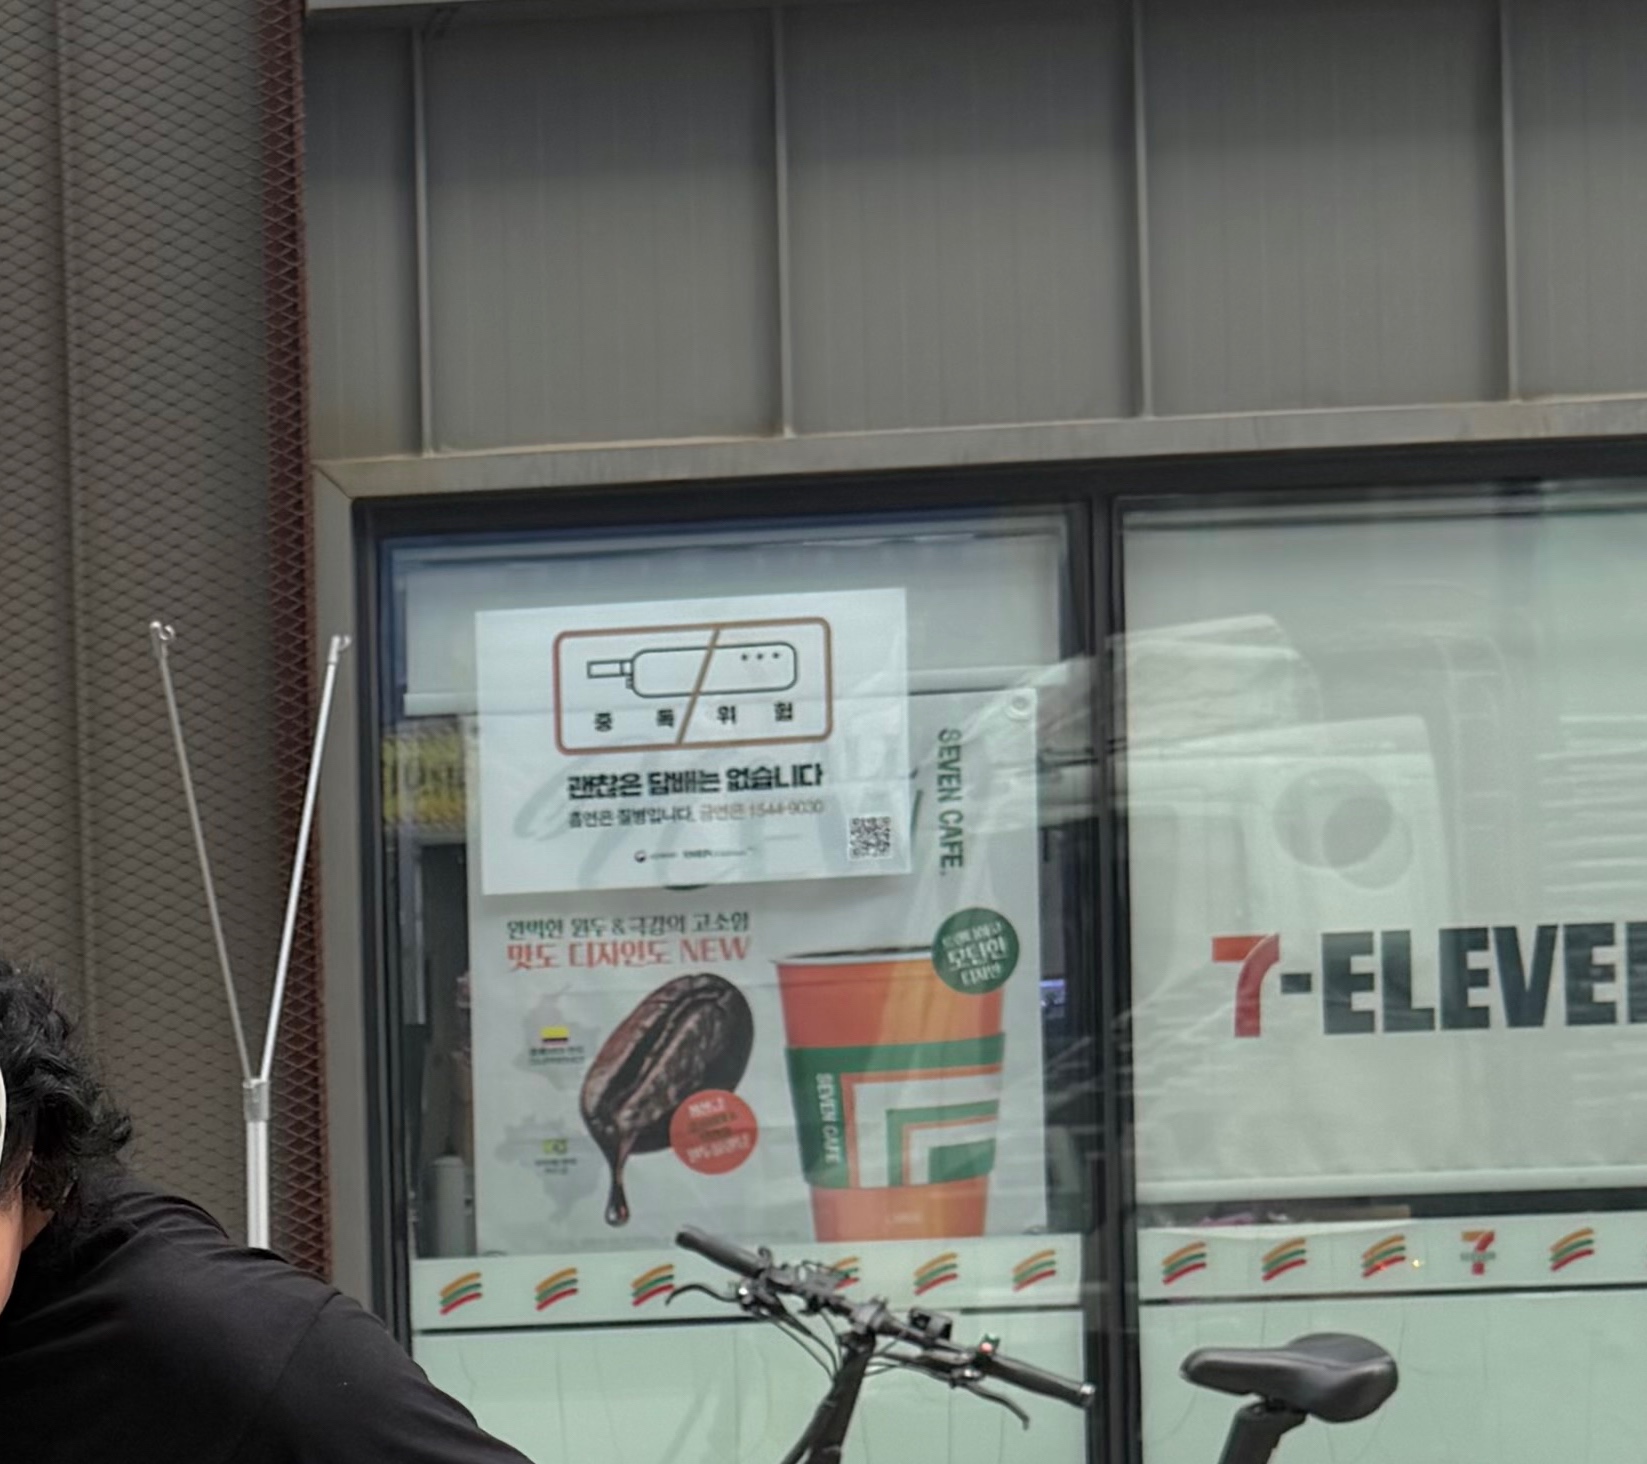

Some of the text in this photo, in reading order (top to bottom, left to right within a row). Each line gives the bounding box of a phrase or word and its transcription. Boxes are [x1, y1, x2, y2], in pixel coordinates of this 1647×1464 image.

[567, 763, 824, 800] 괜찮은 담배는 없습니다
[937, 728, 963, 804] SEVEN
[507, 936, 751, 970] 맛도 디자인도 NEW
